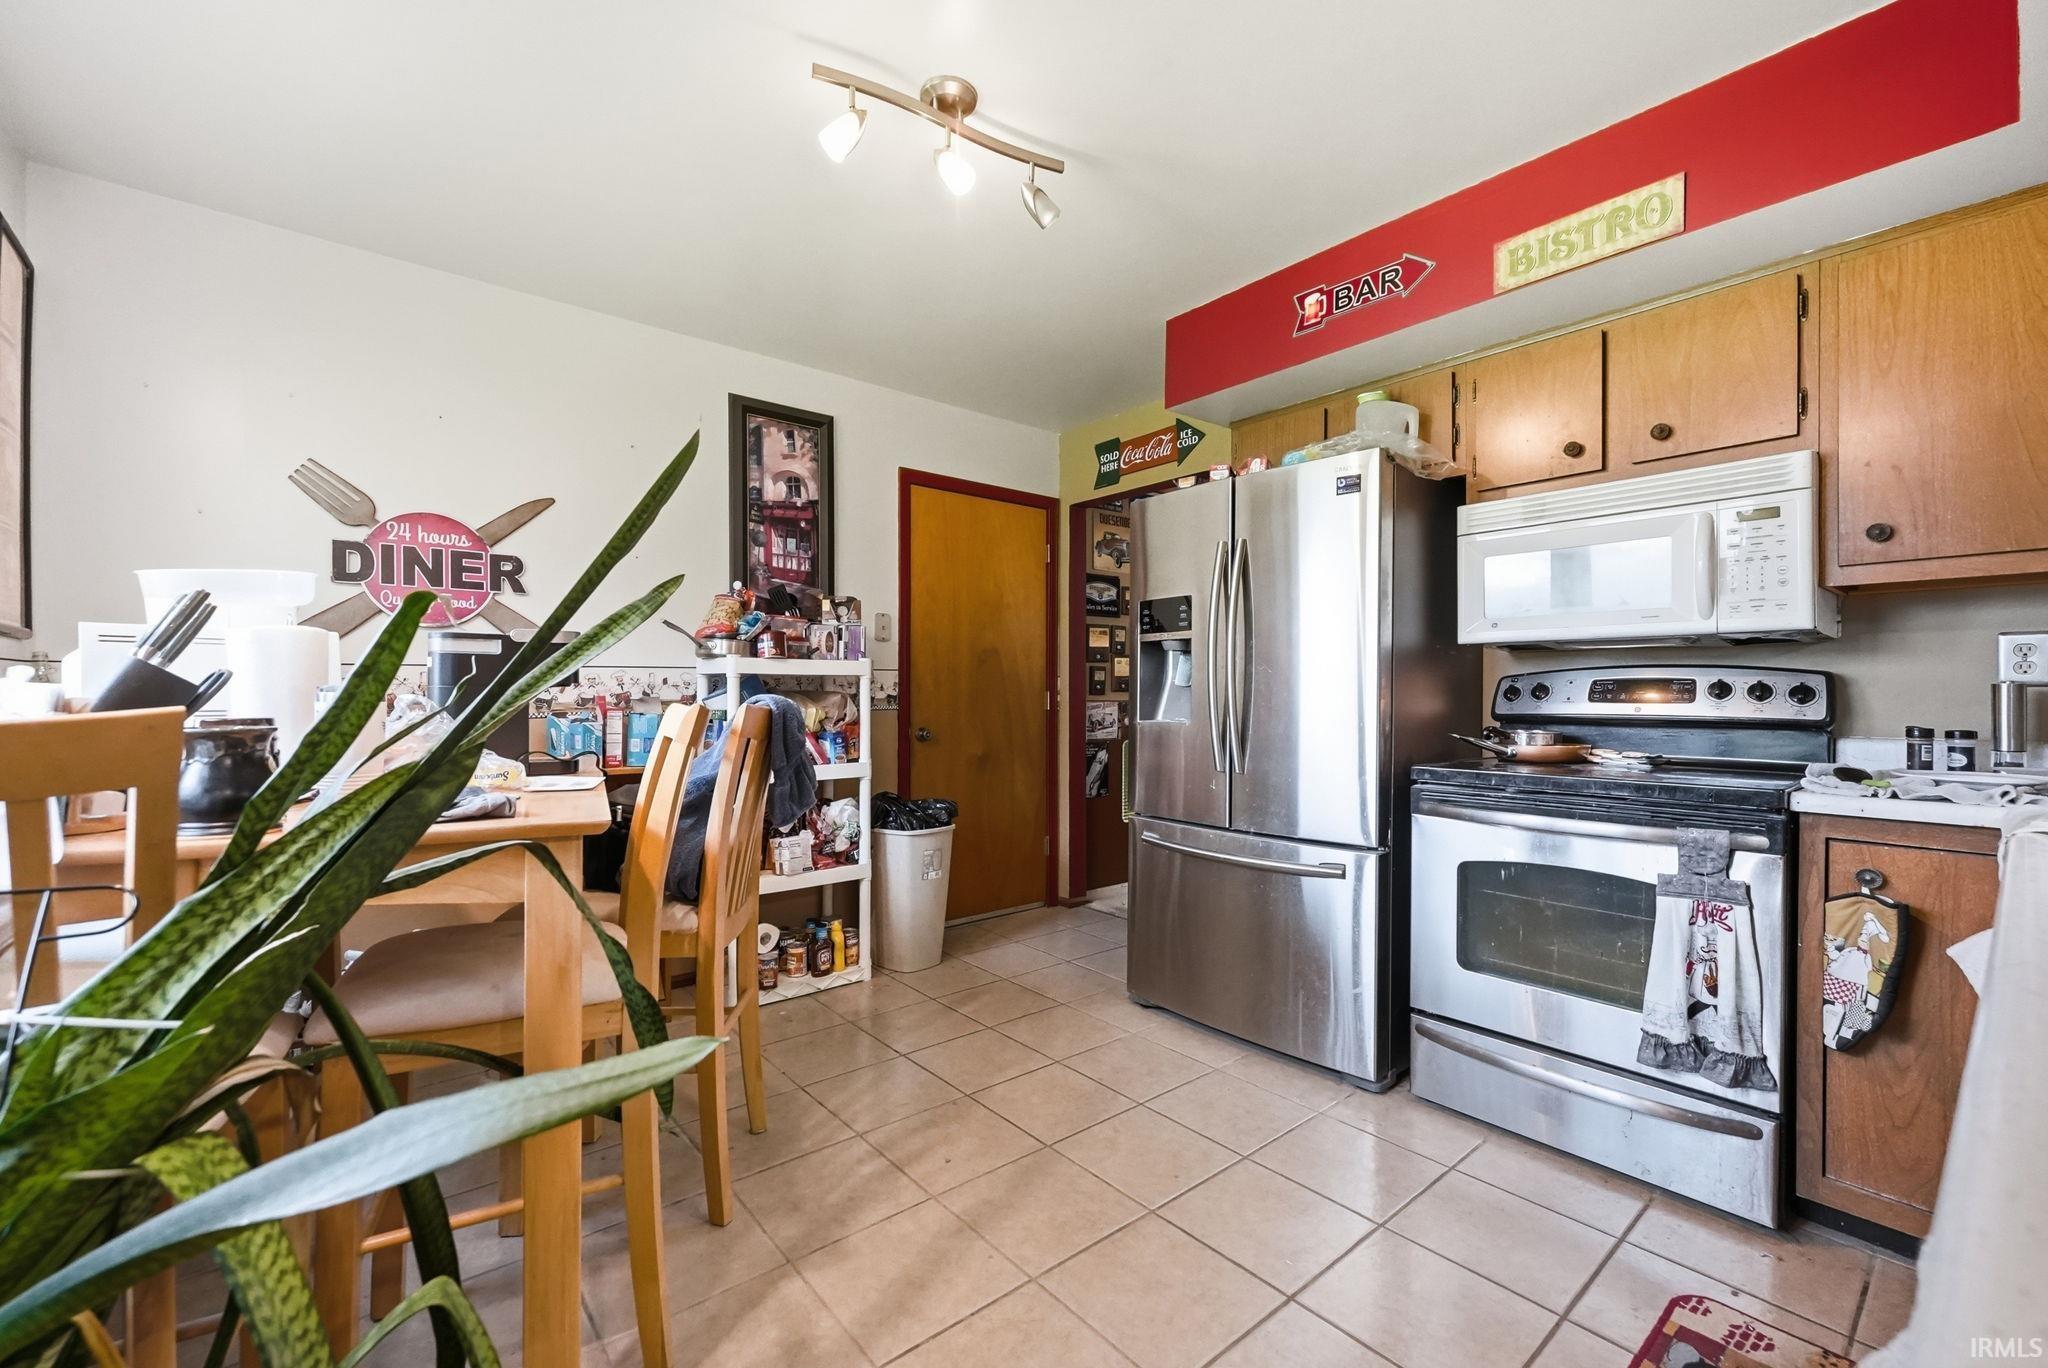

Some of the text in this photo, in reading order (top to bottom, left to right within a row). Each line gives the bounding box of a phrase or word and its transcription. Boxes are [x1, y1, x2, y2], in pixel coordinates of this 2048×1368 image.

[1506, 191, 1674, 277] BISTRO
[1332, 264, 1404, 313] BAR
[1177, 435, 1199, 448] COLD
[1180, 428, 1192, 439] ICE
[1100, 450, 1119, 464] SOLD
[1120, 432, 1175, 469] Coca-Cola
[1100, 461, 1119, 473] HERE
[385, 521, 472, 547] 24 hours
[331, 539, 528, 595] DINER
